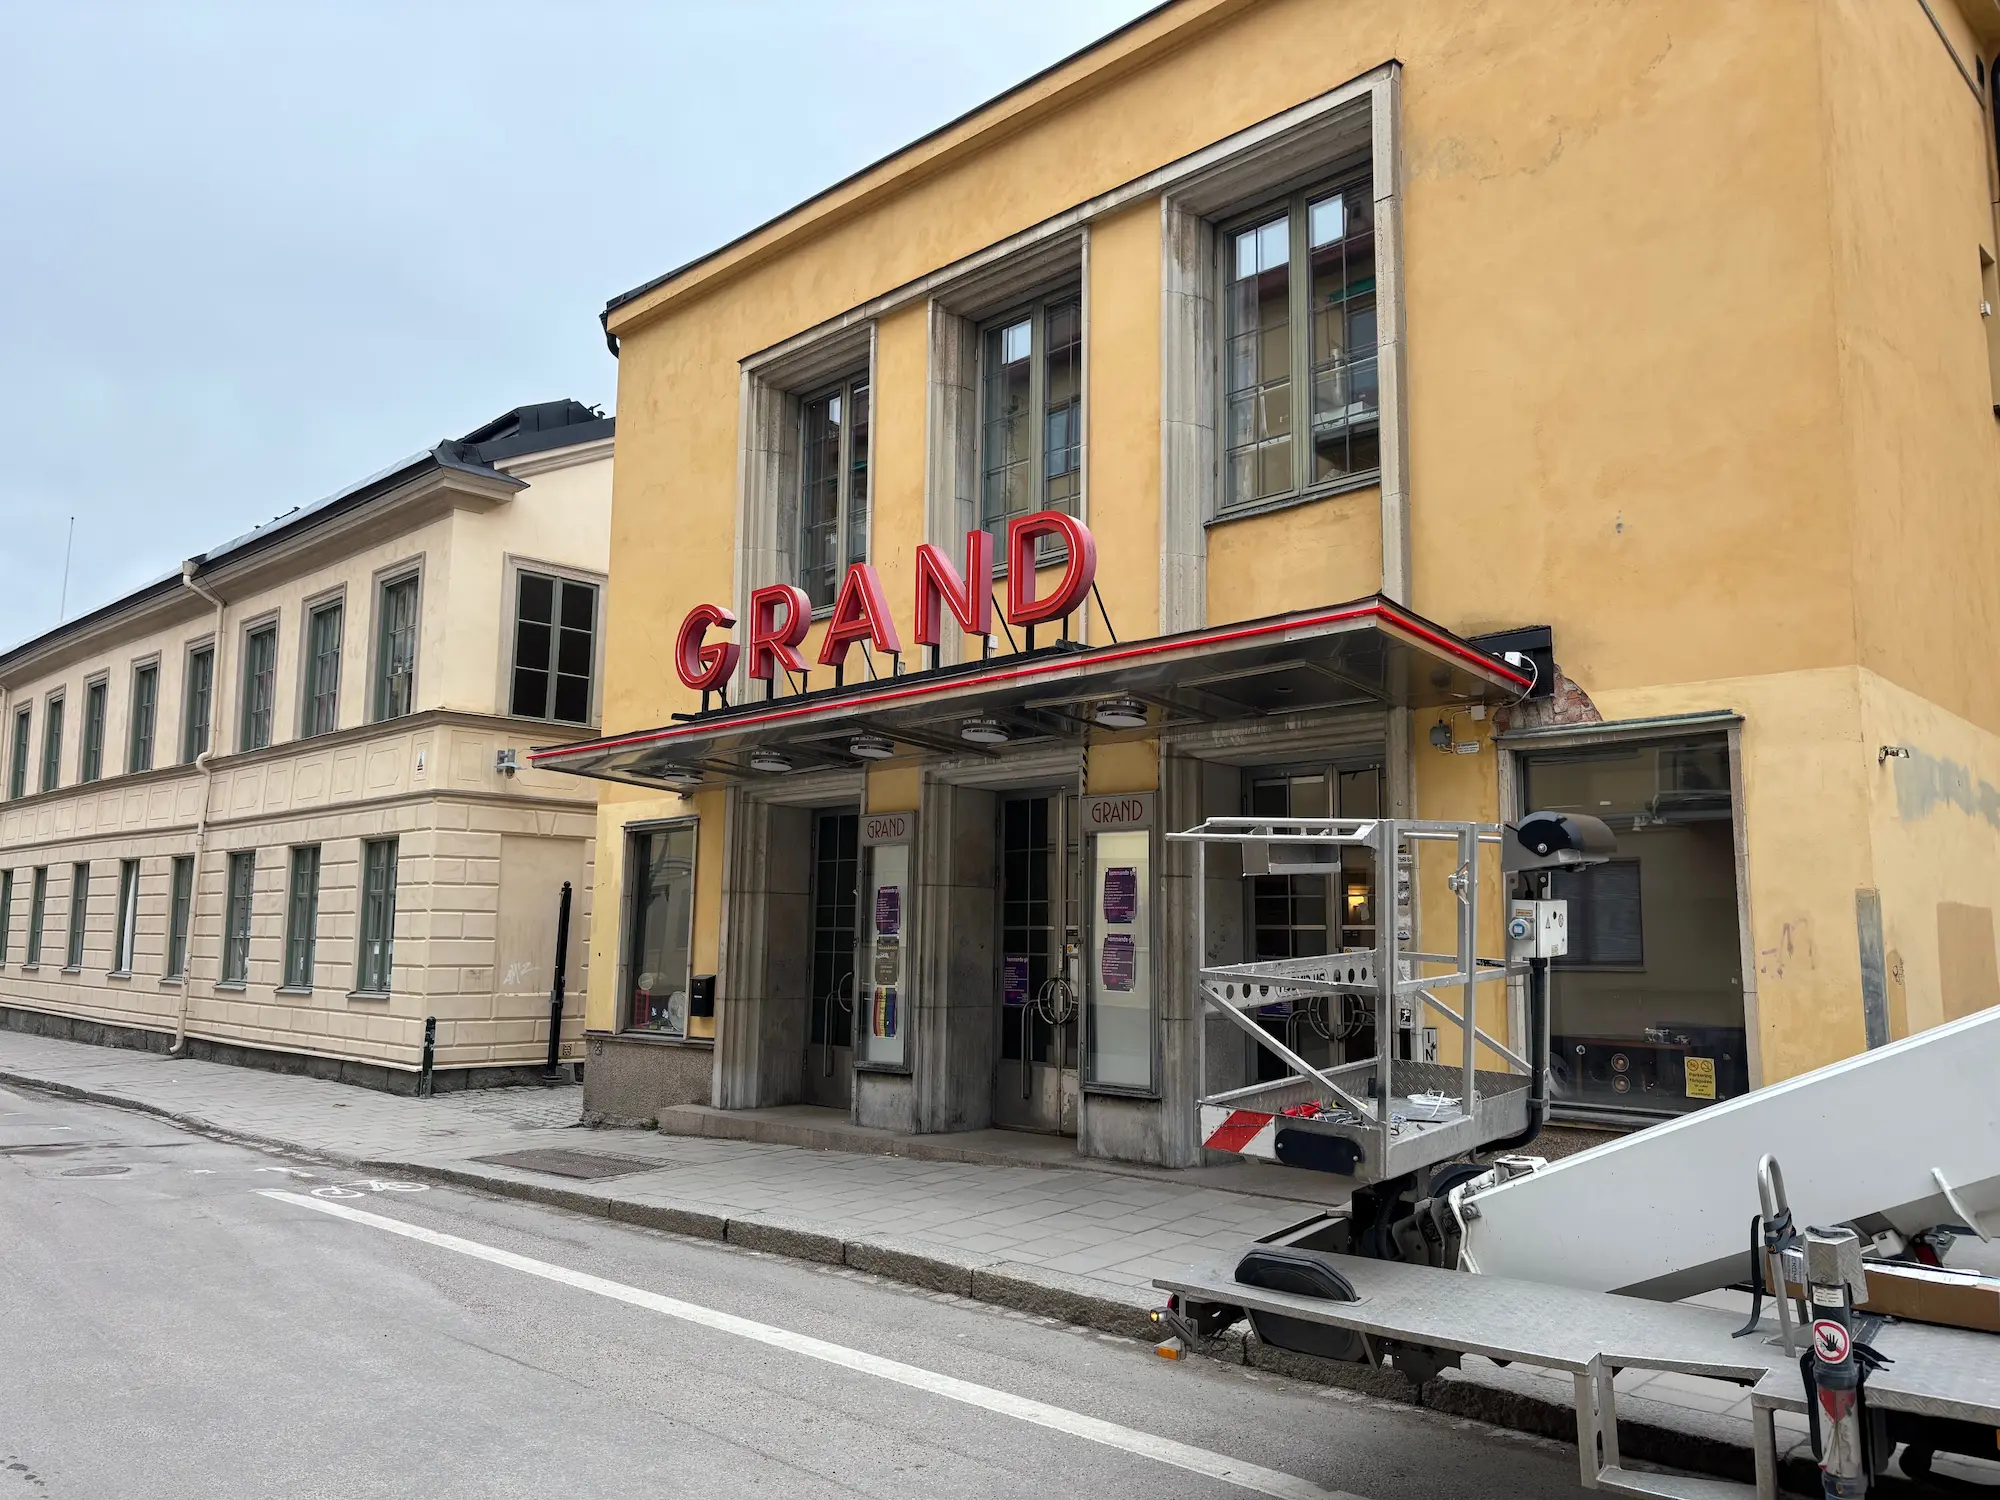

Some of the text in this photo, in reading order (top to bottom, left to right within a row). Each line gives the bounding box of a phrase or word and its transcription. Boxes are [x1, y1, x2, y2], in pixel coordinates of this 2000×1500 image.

[675, 510, 1097, 691] GRAND
[1091, 800, 1143, 823] GRAND
[867, 817, 905, 839] GRAND
